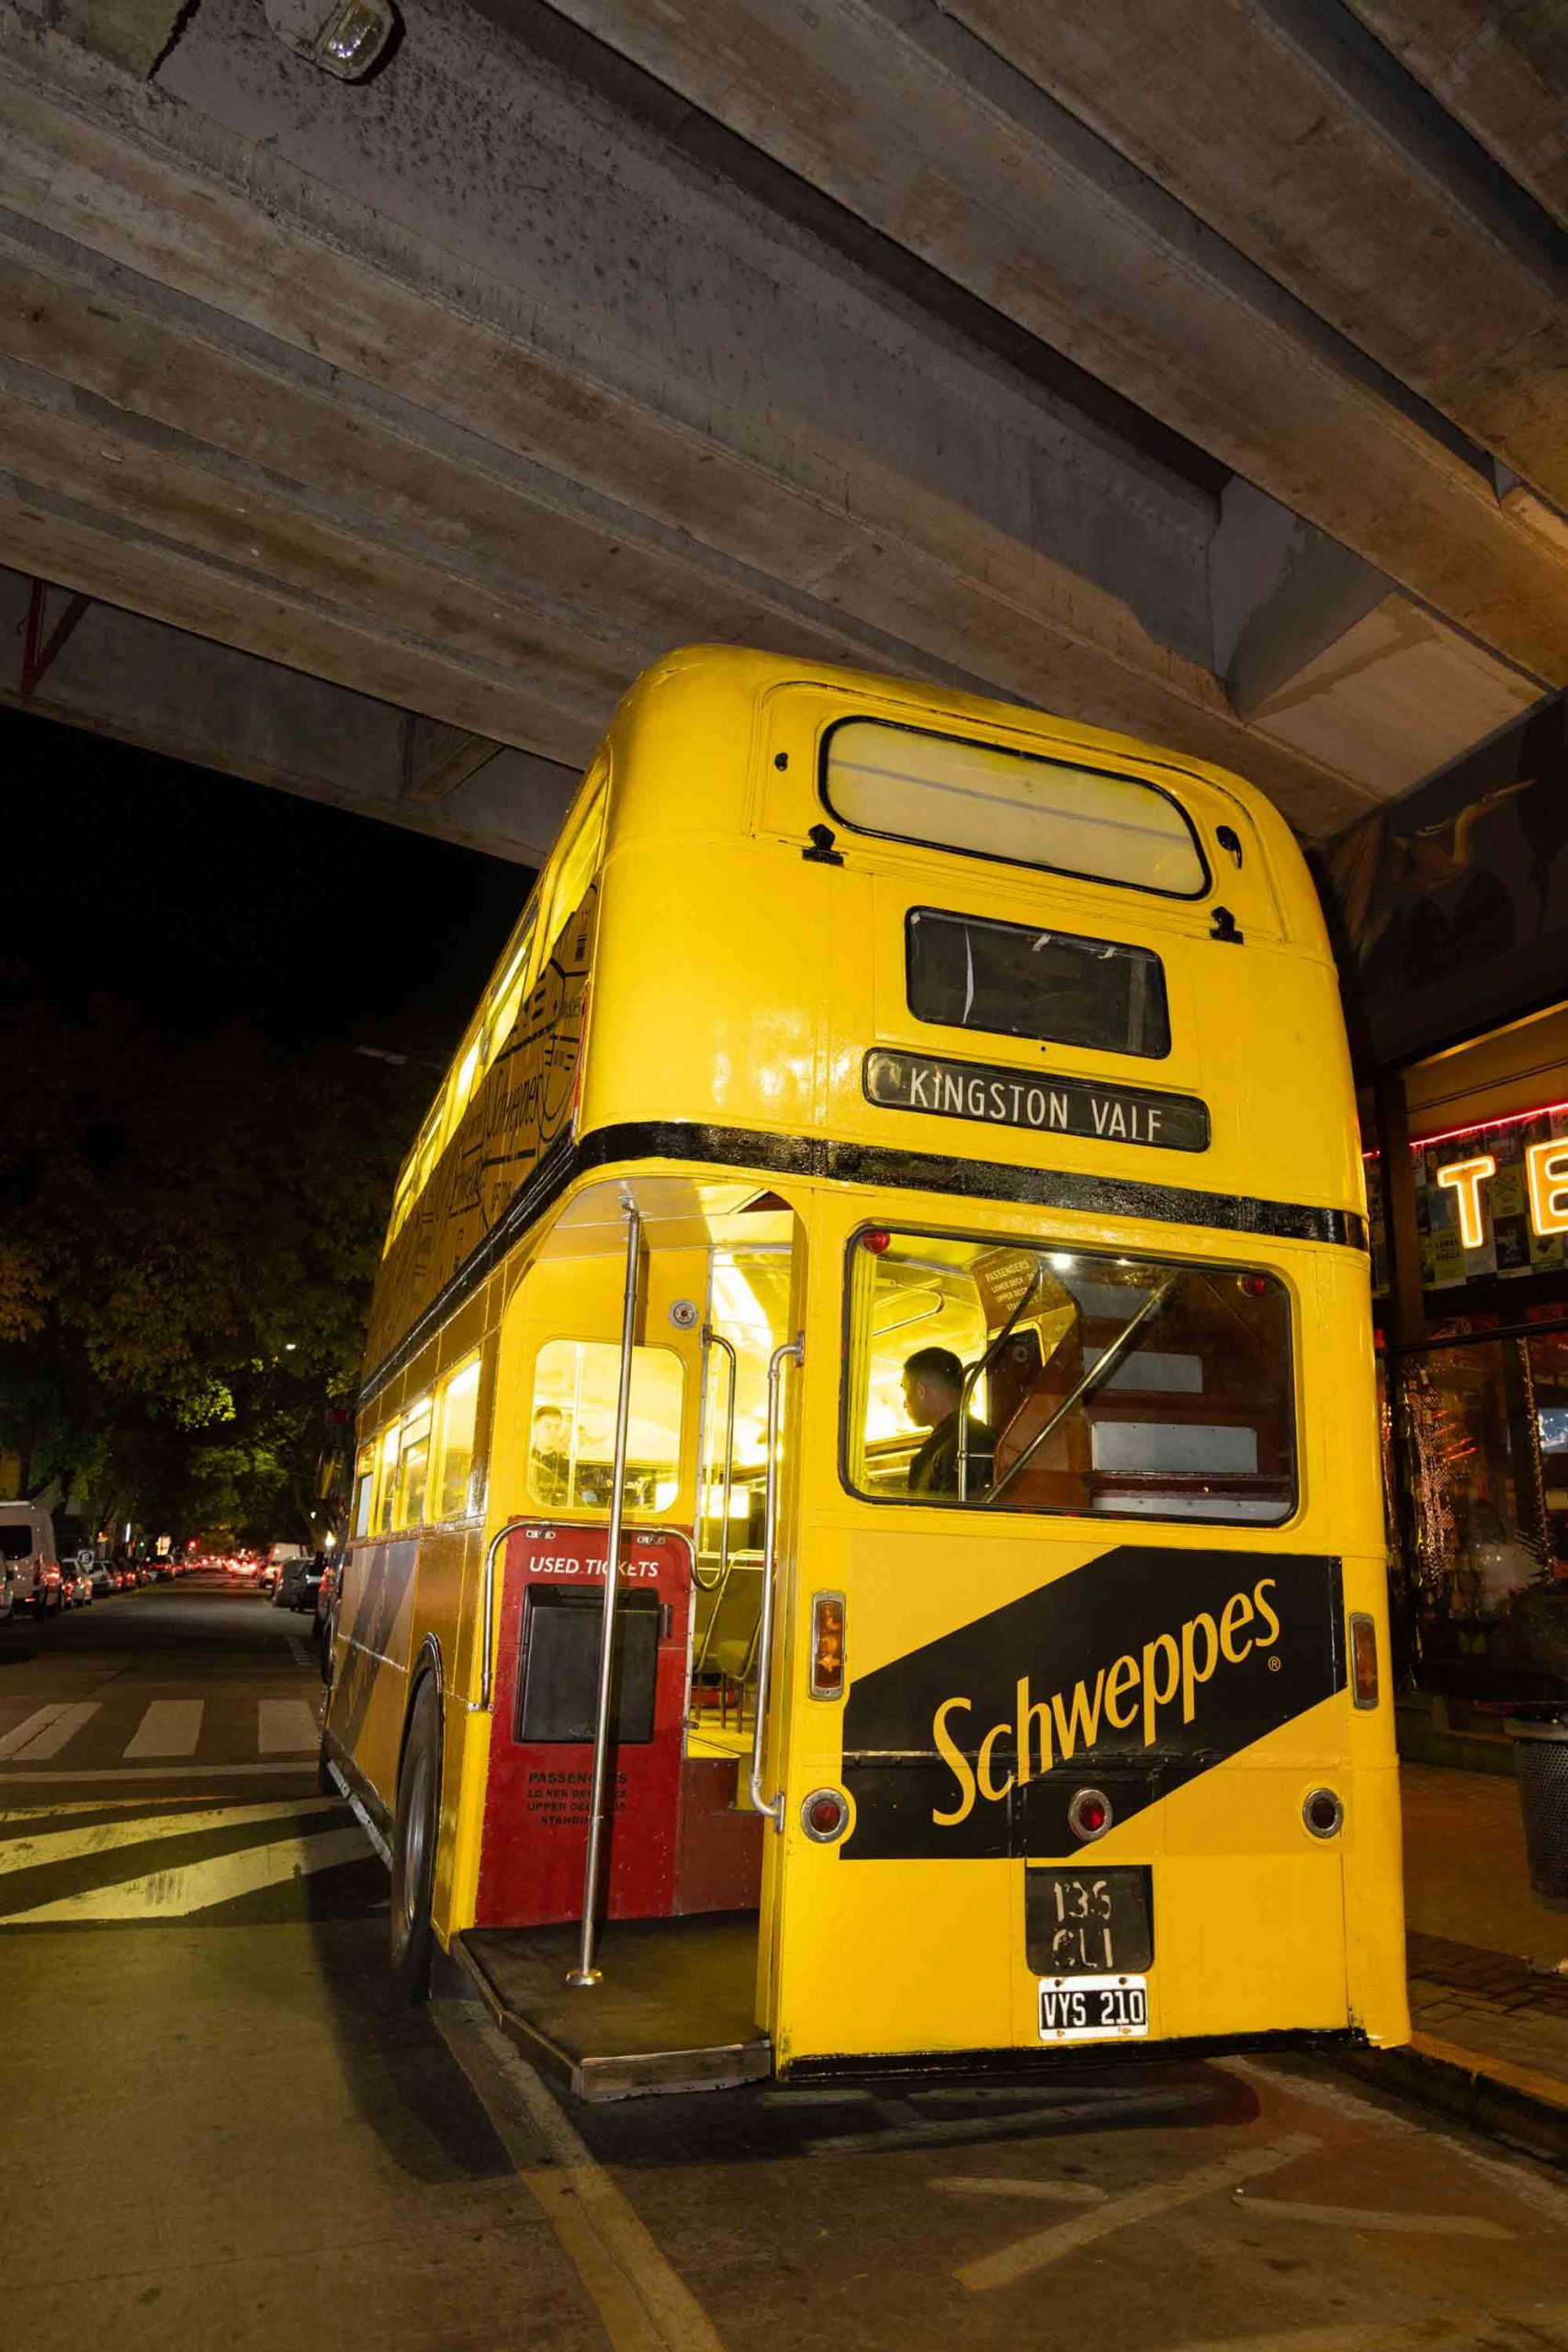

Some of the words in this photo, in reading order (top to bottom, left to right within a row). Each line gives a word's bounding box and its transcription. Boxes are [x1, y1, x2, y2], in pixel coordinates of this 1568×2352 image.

[908, 1068, 1068, 1129] KINGSTON
[985, 1259, 1030, 1283] PASSENGERS
[529, 1556, 580, 1574] USED
[931, 1577, 1280, 1826] Schweppes
[1043, 1992, 1088, 2028] VYS
[1100, 1990, 1145, 2025] 210
